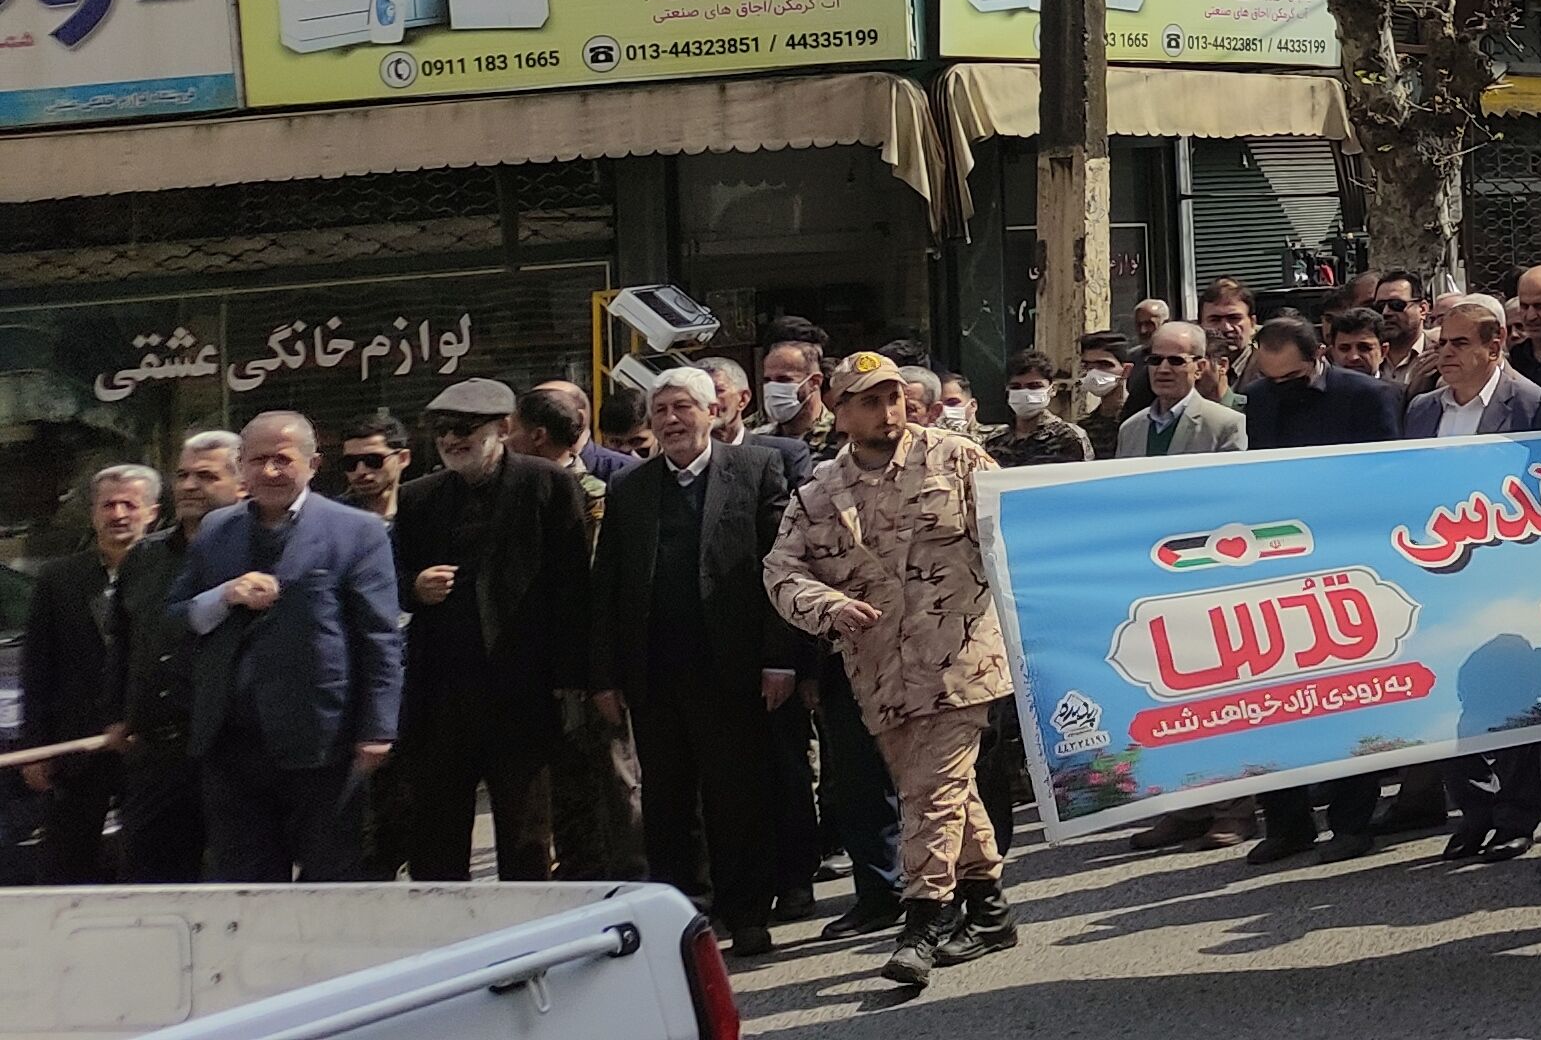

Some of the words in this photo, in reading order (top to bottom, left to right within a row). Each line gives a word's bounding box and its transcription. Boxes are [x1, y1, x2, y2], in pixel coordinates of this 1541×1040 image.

[652, 8, 700, 24] صنعتی
[704, 4, 731, 20] های
[625, 36, 760, 62] 013-44323851
[785, 29, 878, 51] 44335199
[1121, 33, 1149, 48] 1665
[1188, 36, 1263, 52] 013-44323851
[1276, 38, 1326, 53] 44335199
[421, 56, 467, 79] 0911
[473, 53, 508, 74] 183
[516, 49, 561, 71] 1665
[227, 316, 355, 392] خانگی
[361, 313, 472, 382] لوازم
[94, 327, 220, 402] عشقی
[1284, 684, 1319, 714] آزاد
[1322, 679, 1384, 711] زودی
[1385, 674, 1413, 697] به
[1152, 705, 1200, 738] شد
[1202, 697, 1282, 729] خواهد
